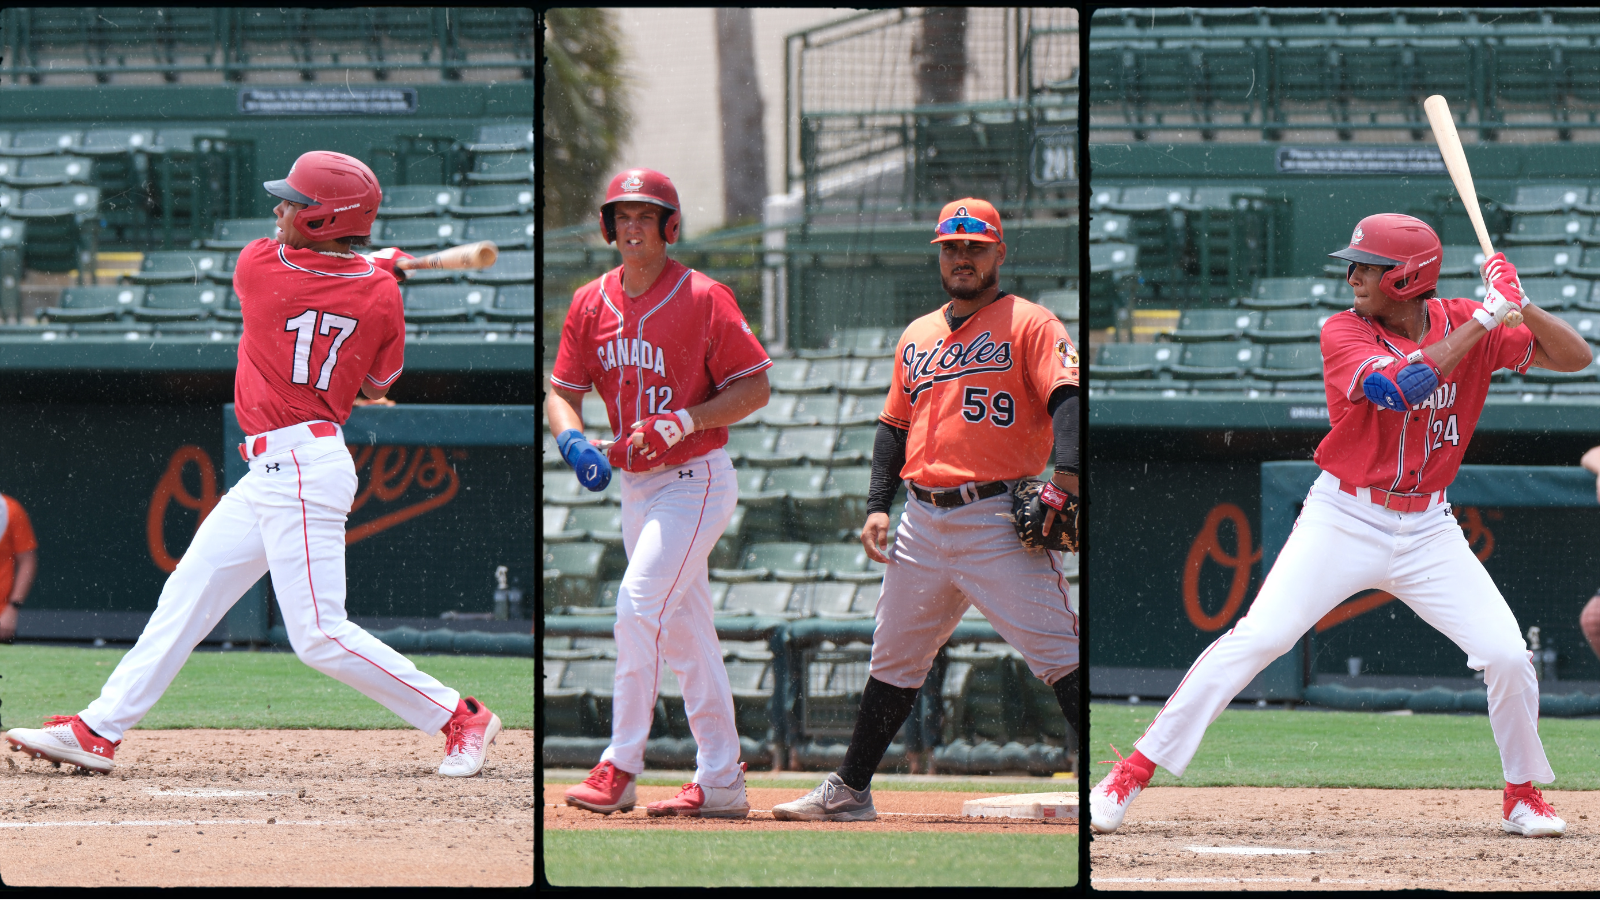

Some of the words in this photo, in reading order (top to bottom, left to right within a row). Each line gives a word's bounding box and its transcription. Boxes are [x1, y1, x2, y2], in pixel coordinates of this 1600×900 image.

[284, 308, 359, 391] 17
[597, 338, 666, 378] CANADA
[902, 331, 1013, 385] Orioles
[645, 385, 673, 414] 12
[961, 386, 1015, 428] 59
[1377, 382, 1457, 411] ADA
[1431, 414, 1460, 451] 24
